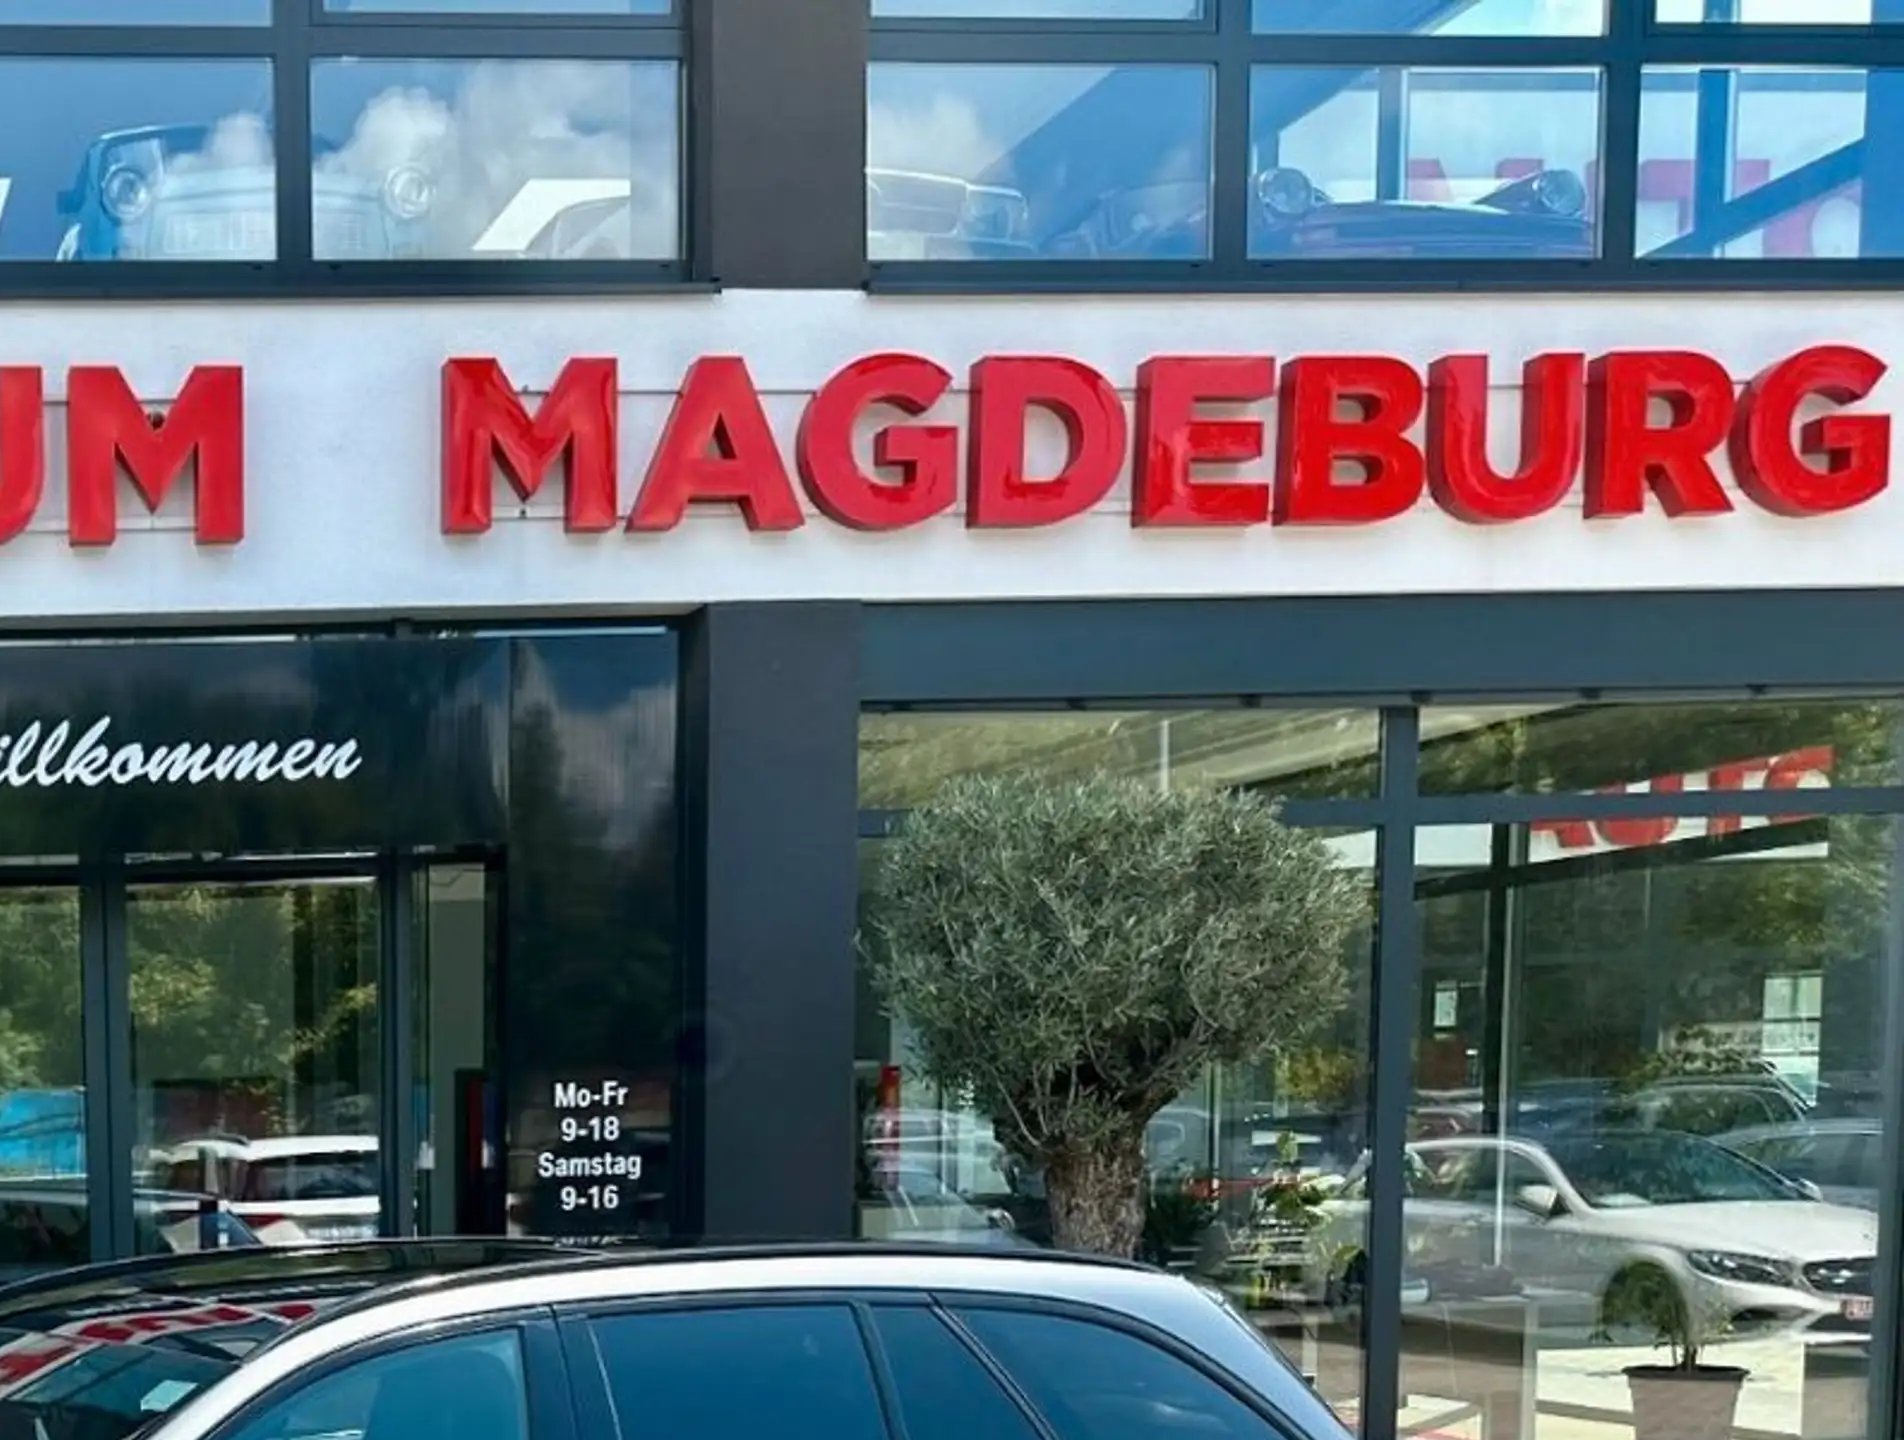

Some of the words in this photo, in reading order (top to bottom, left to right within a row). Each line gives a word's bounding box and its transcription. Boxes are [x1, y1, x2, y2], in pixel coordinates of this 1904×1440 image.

[441, 345, 1892, 533] MAGDEBURG
[554, 1080, 629, 1108] Mo-Fr
[561, 1115, 620, 1142] 9-18
[538, 1151, 642, 1180] Samstag
[560, 1184, 620, 1211] 9-16
